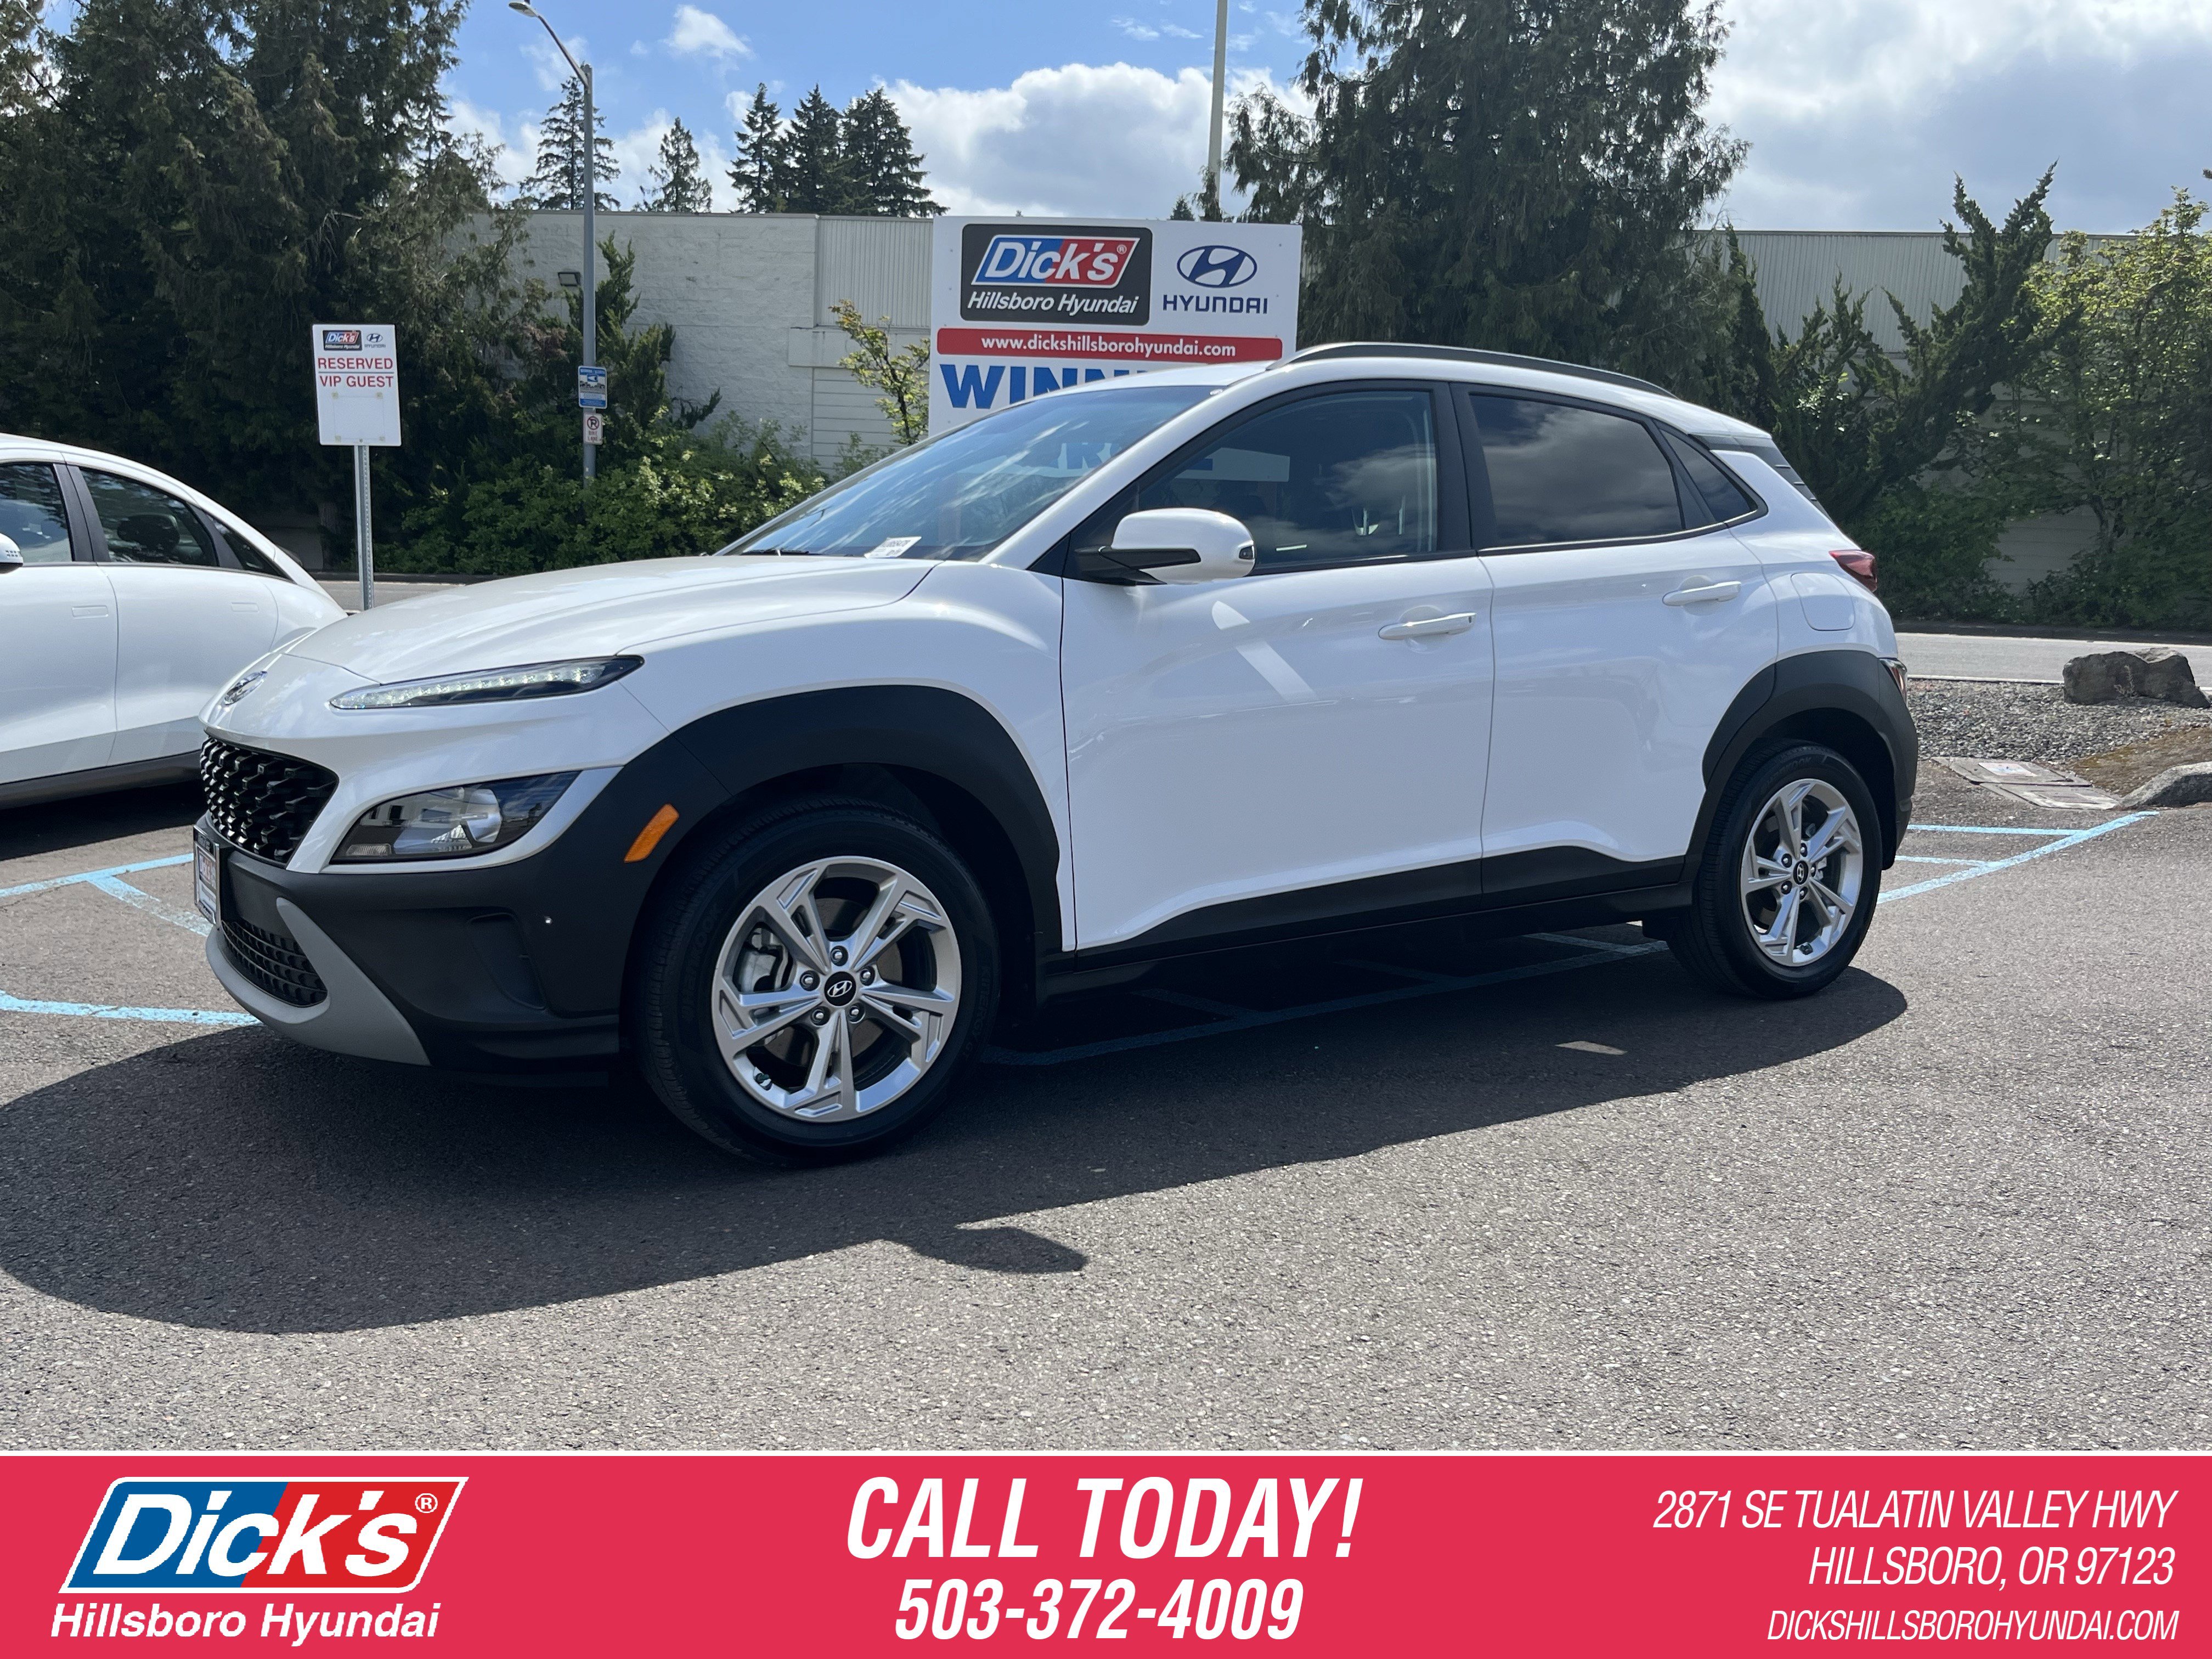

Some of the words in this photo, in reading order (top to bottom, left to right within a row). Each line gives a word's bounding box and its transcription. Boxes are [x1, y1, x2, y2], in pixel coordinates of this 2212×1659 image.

[968, 291, 1054, 311] Hillsboro
[1057, 294, 1139, 317] Hyundai
[1163, 295, 1268, 314] HYUNDAI
[981, 334, 1236, 359] www.dickshillsborohyundai.com
[318, 358, 393, 369] RESERVED
[320, 376, 341, 387] VIP
[346, 375, 394, 387] GUEST
